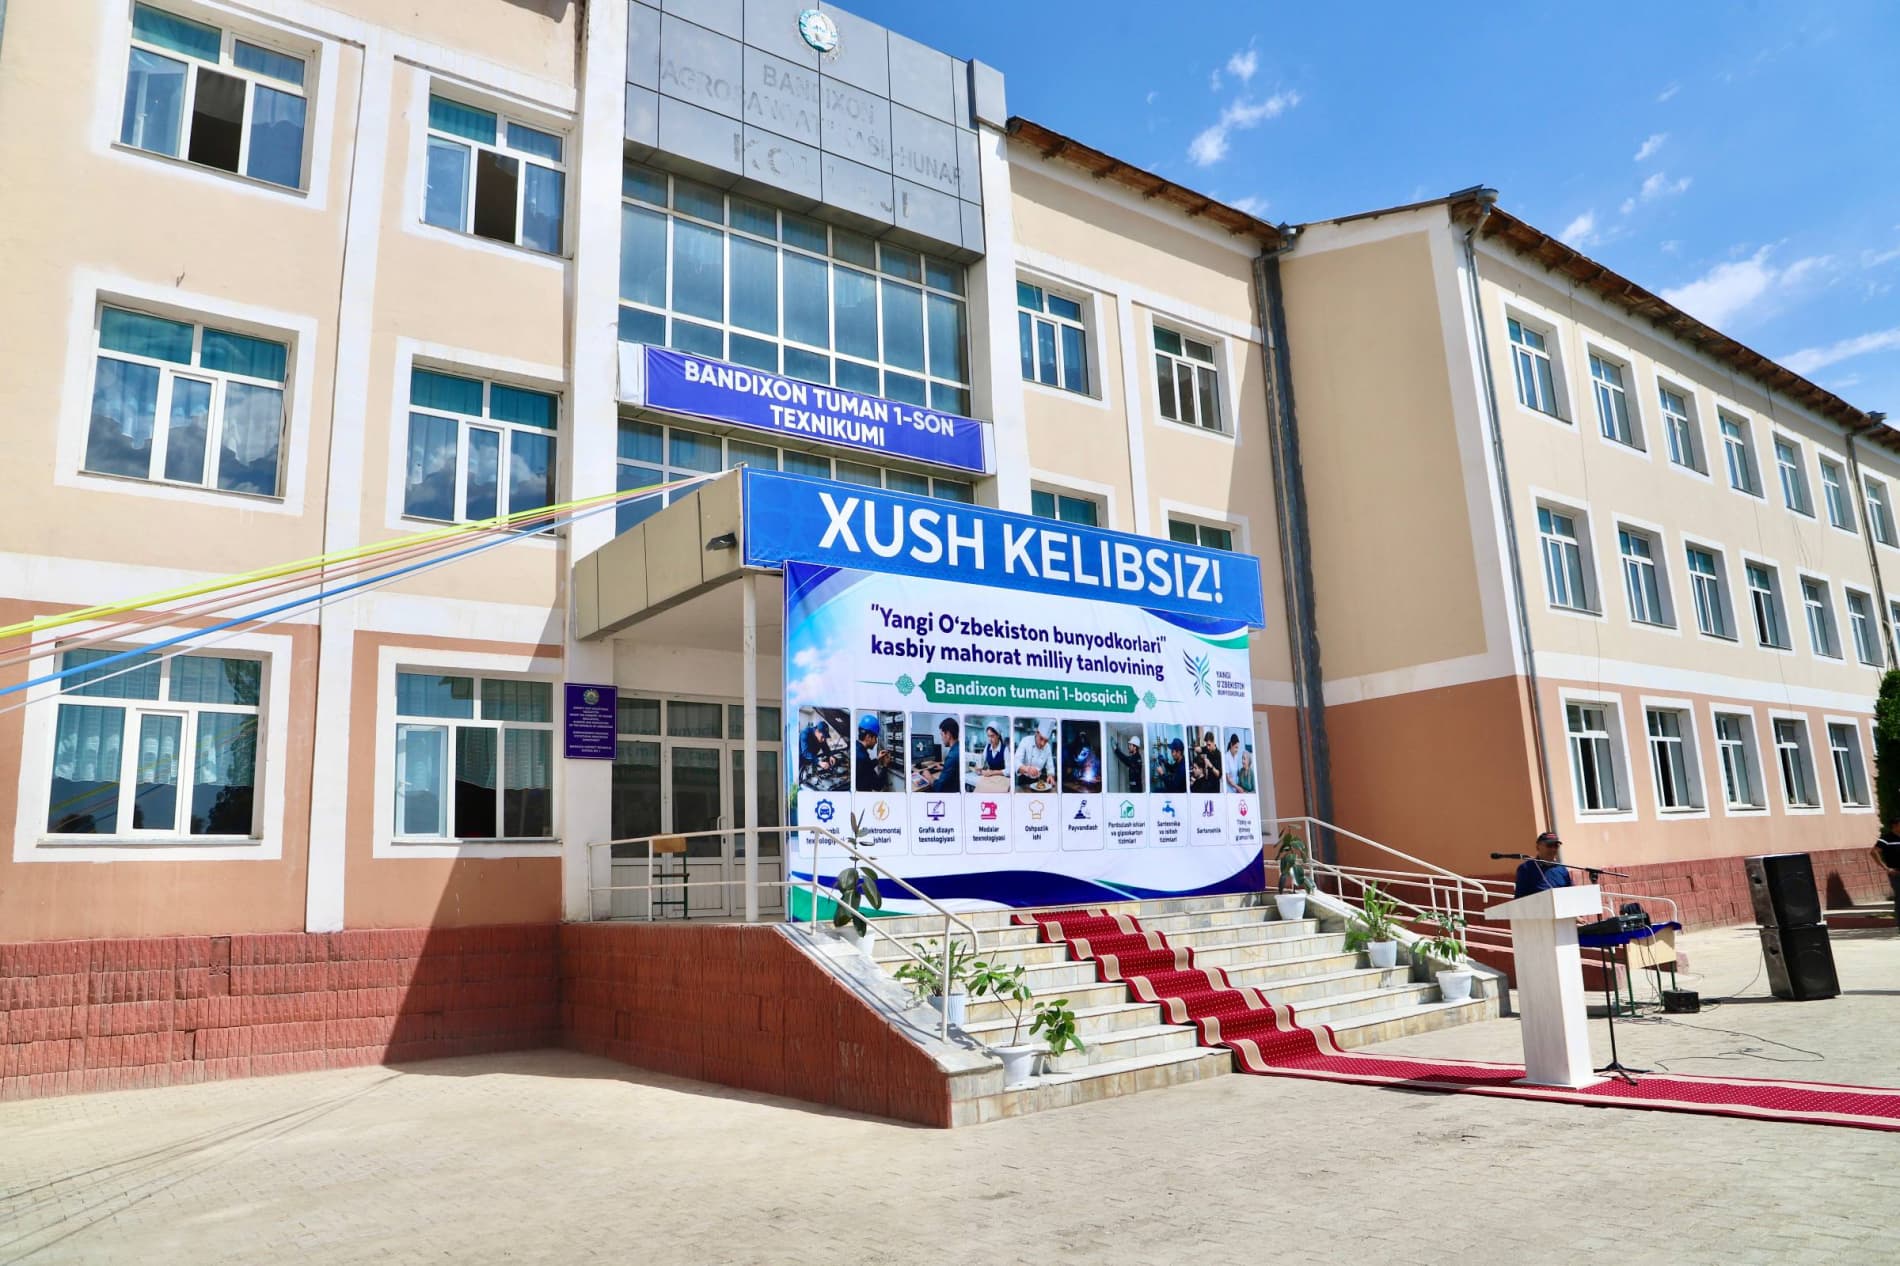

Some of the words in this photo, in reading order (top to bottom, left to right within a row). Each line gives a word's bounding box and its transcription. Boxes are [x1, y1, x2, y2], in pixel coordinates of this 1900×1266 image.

[684, 359, 807, 405] BANDIXON
[812, 388, 888, 423] TUMAN
[892, 406, 954, 437] 1-SON
[769, 404, 885, 447] TEXNIKUMI
[818, 492, 985, 570] XUSH
[1002, 522, 1224, 604] KELIBSIZ!
[871, 603, 933, 636] "Yangi
[1053, 625, 1167, 654] bunyodkorlari"
[871, 634, 936, 663] kasbiy
[940, 643, 1022, 666] mahorat
[1026, 648, 1073, 674] milliy
[1076, 654, 1165, 682] tanlovining
[934, 678, 1006, 697] Bandixon
[1010, 684, 1060, 701] tumani
[1062, 686, 1128, 706] 1-bosqichi
[918, 826, 935, 834] Grafik
